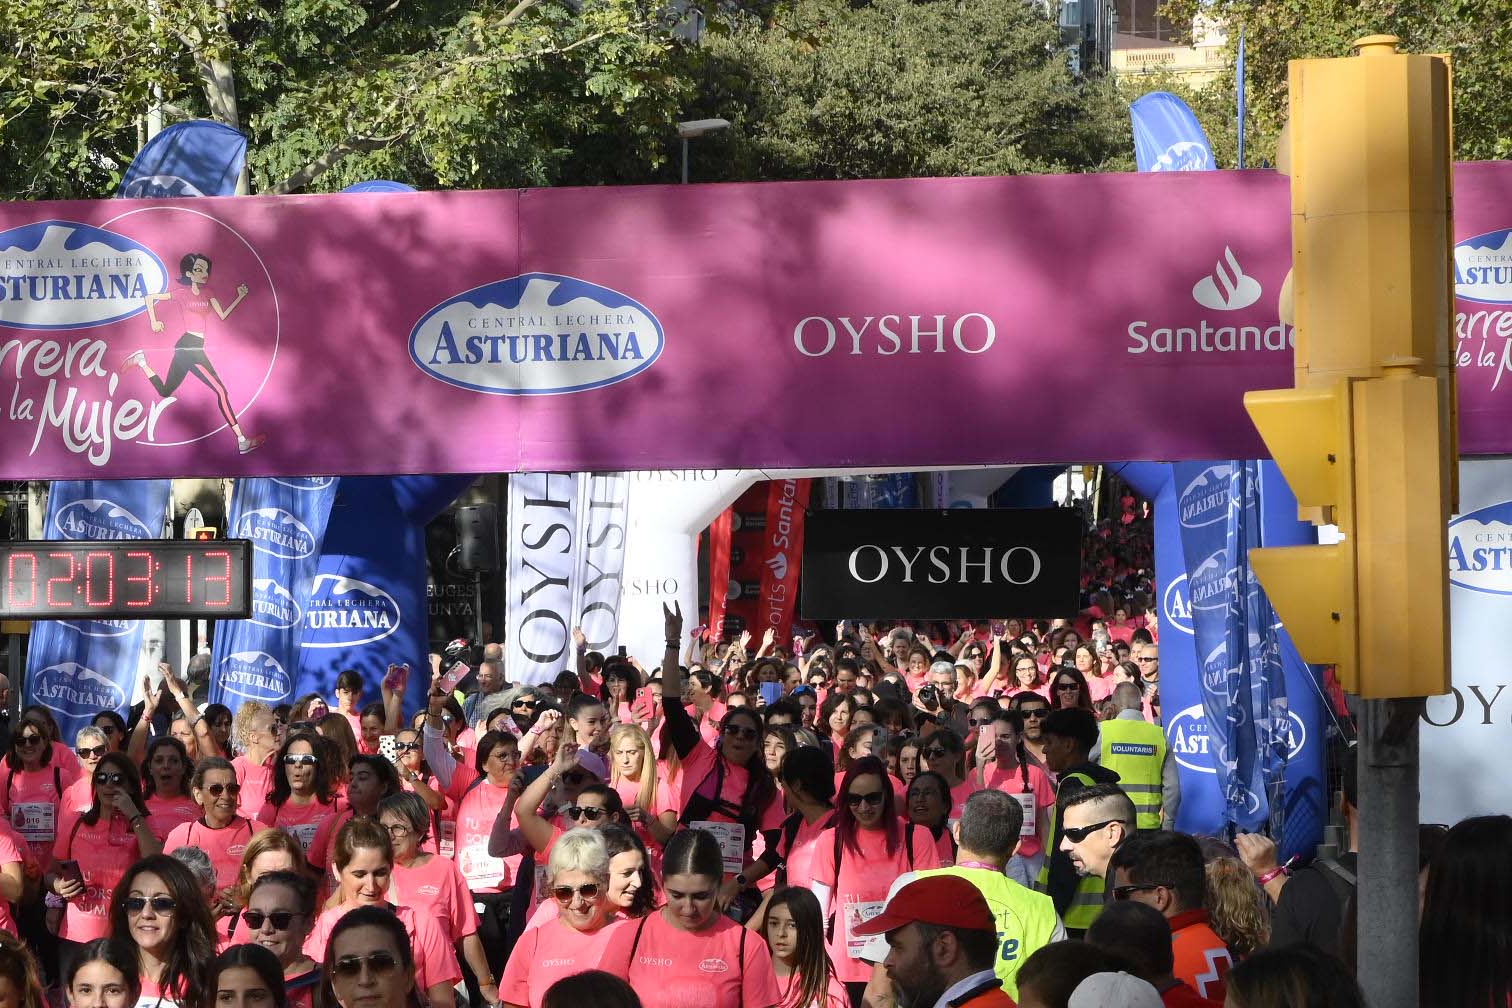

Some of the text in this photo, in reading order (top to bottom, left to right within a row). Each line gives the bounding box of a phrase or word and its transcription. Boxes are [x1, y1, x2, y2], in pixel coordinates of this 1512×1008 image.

[71, 257, 144, 269] LECHERA
[1469, 255, 1512, 263] CENTRA
[468, 314, 636, 330] CENTRAL LECHERA
[1456, 310, 1512, 339] arre
[428, 320, 646, 366] ASTURIANA
[793, 312, 997, 358] OYSHO
[9, 381, 35, 421] la
[29, 373, 179, 467] Mujer
[240, 520, 309, 554] ASTURIANA
[1475, 533, 1512, 543] CENT
[519, 473, 573, 665] OYSH
[848, 544, 1042, 585] OYSHO
[8, 552, 231, 607] 02:03:13
[631, 577, 678, 596] SHO
[252, 599, 294, 624] TURIANA
[310, 599, 334, 607] TRAL
[429, 603, 473, 616] UNYA
[305, 610, 391, 630] TURIANA
[220, 669, 285, 695] ASTURIANA
[37, 681, 117, 710] ASTURIANA
[1112, 744, 1153, 756] VOLUNTARIS
[639, 956, 673, 967] OYSHO
